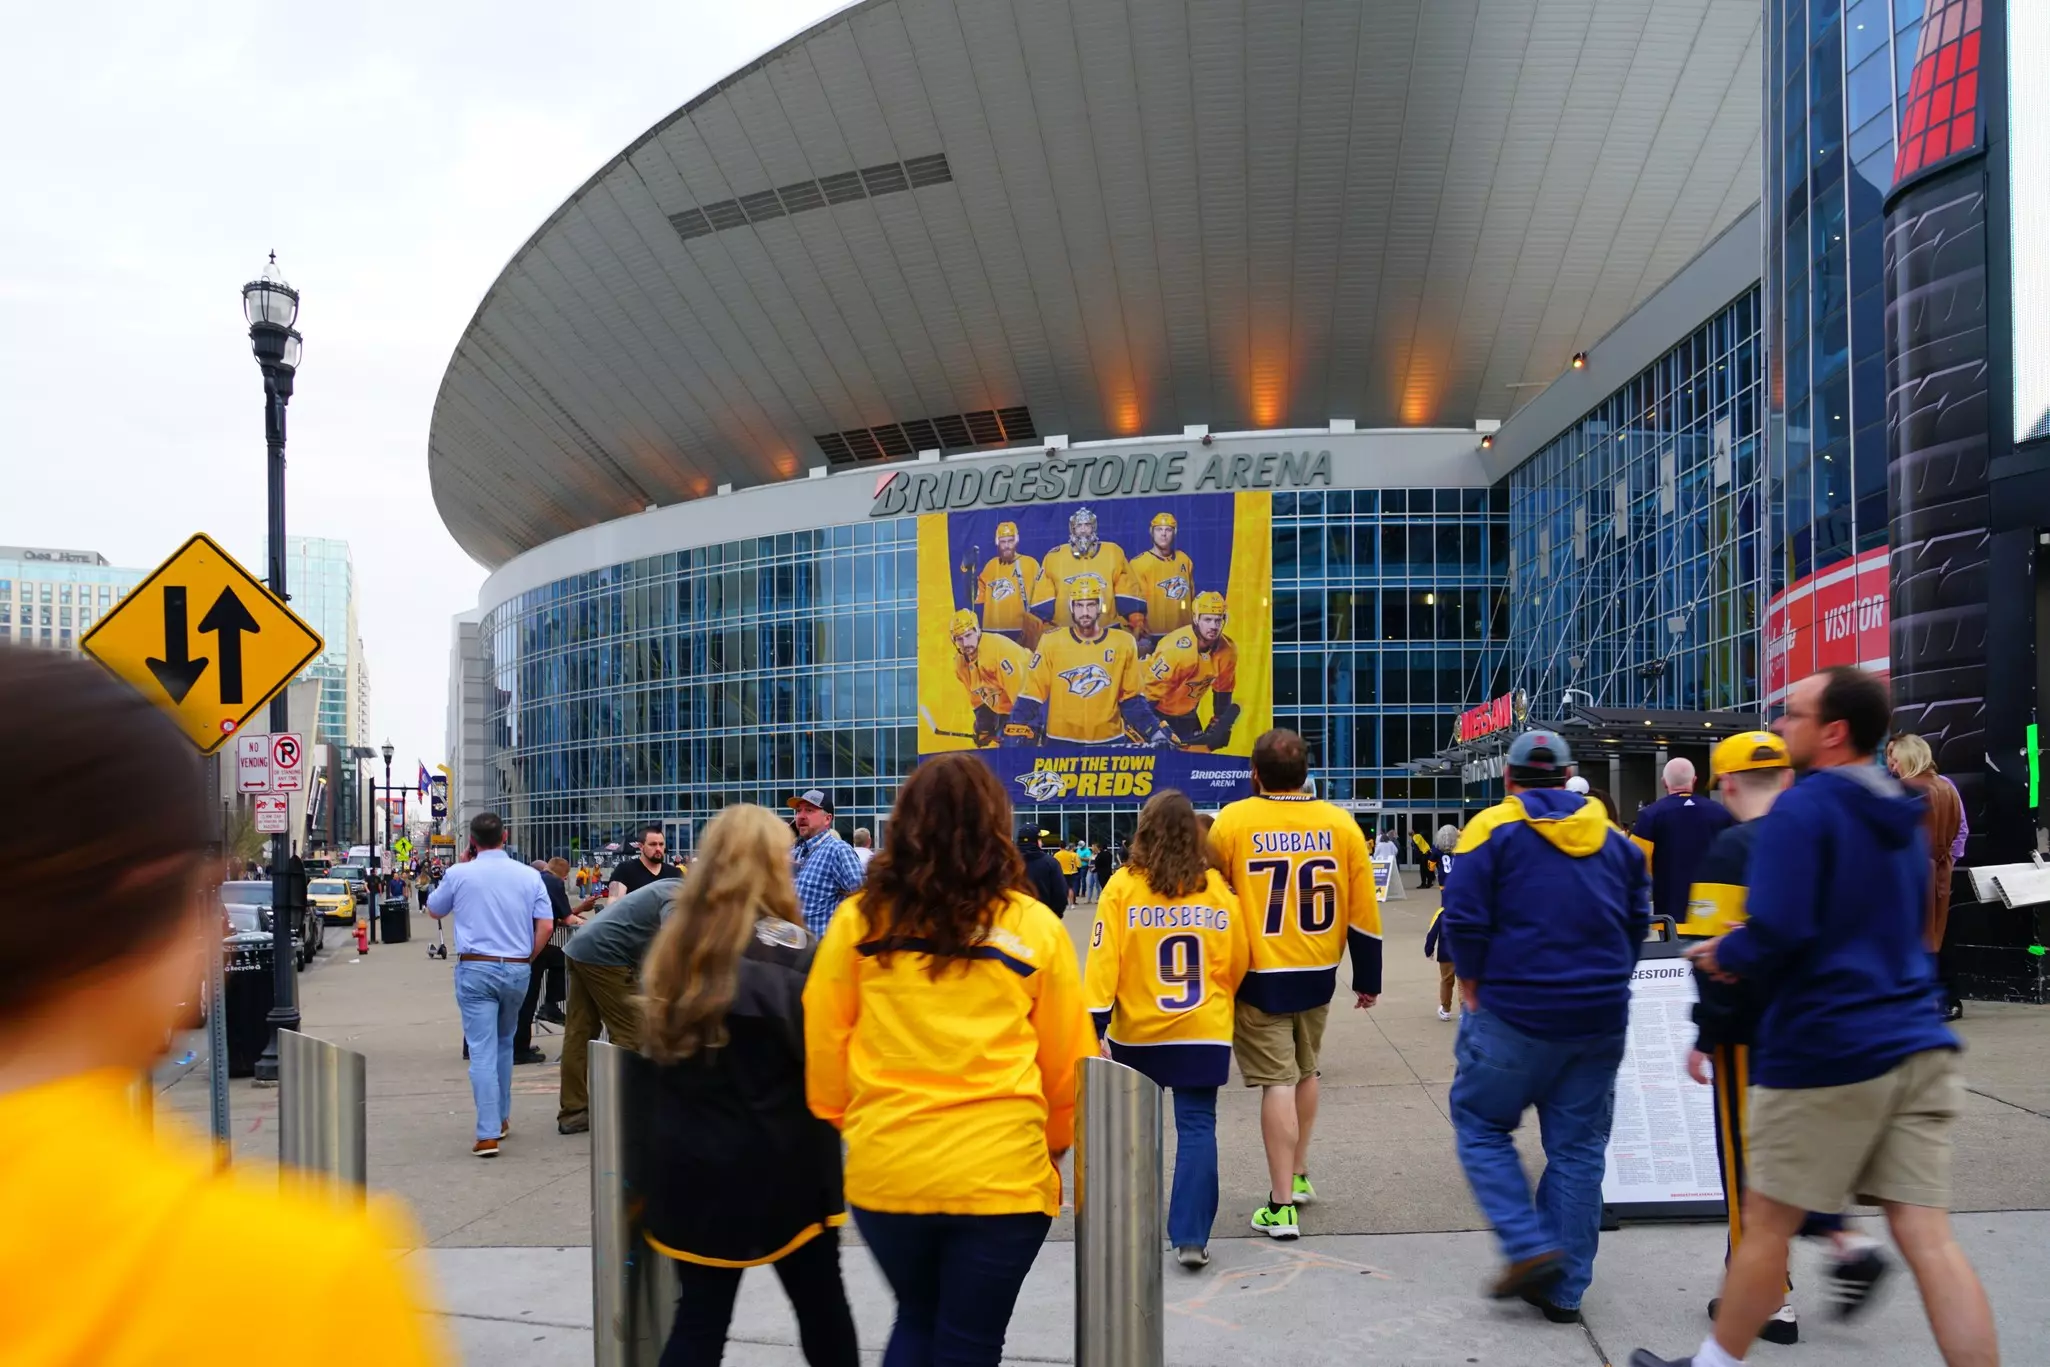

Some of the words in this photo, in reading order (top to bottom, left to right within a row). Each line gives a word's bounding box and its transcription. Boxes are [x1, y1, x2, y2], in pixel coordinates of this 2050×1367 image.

[869, 451, 1188, 517] BRIDGESTONE
[1195, 450, 1332, 490] ARENA
[1824, 593, 1884, 643] VISITOR
[1001, 659, 1014, 676] 9
[1104, 649, 1115, 663] C
[1461, 692, 1513, 742] NISSAN
[248, 742, 259, 753] NO
[240, 756, 268, 768] VENDING
[1034, 757, 1079, 772] PAINT
[1080, 756, 1108, 771] THE
[1111, 755, 1156, 771] TOWN
[1057, 772, 1153, 798] PREDS
[1210, 779, 1236, 787] ARENA
[1252, 831, 1333, 854] SUBBAN
[1246, 856, 1339, 937] 76
[1127, 904, 1230, 931] FORSBERG
[1092, 920, 1104, 949] 9
[1156, 932, 1205, 1013] 9
[1631, 968, 1685, 980] GESTONE
